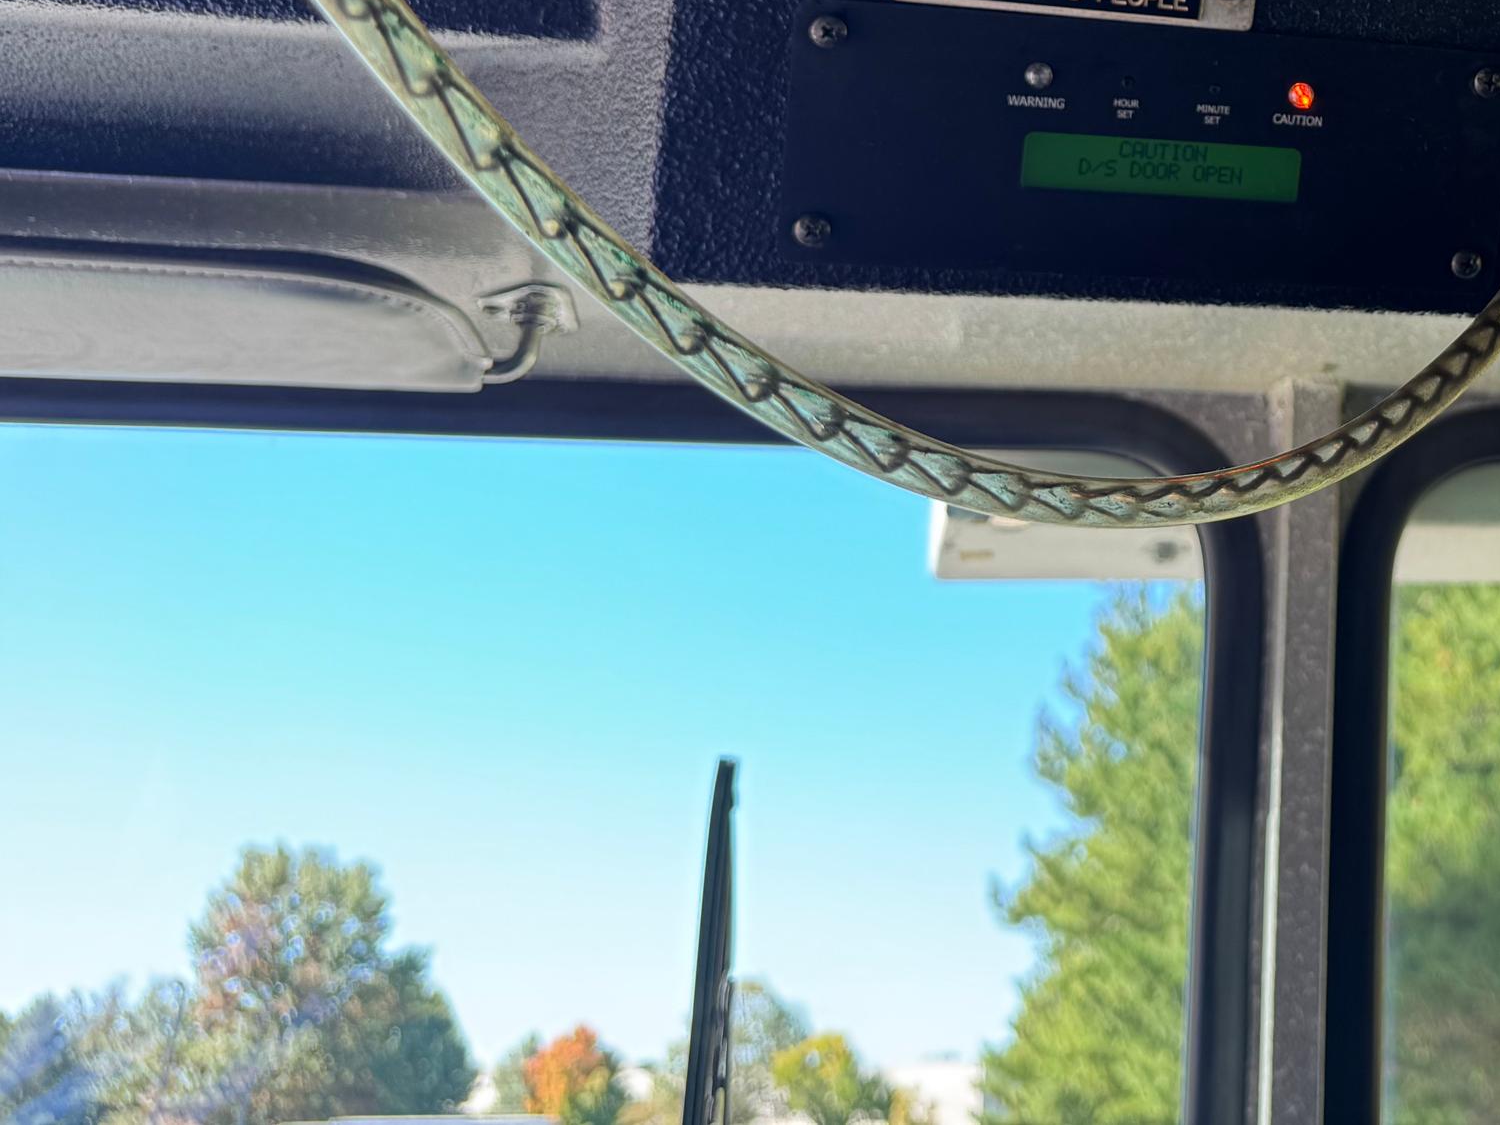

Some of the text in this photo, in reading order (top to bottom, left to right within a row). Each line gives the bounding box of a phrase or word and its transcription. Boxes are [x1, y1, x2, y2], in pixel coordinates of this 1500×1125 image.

[1007, 95, 1066, 110] WARNING
[1114, 98, 1140, 109] HOUR
[1117, 109, 1133, 119] SET
[1197, 104, 1231, 115] MINUTE
[1204, 115, 1221, 125] SET
[1273, 113, 1323, 127] CAUTION
[1119, 140, 1208, 163] CAUTION
[1078, 157, 1244, 185] D/S DOOR OPEN
